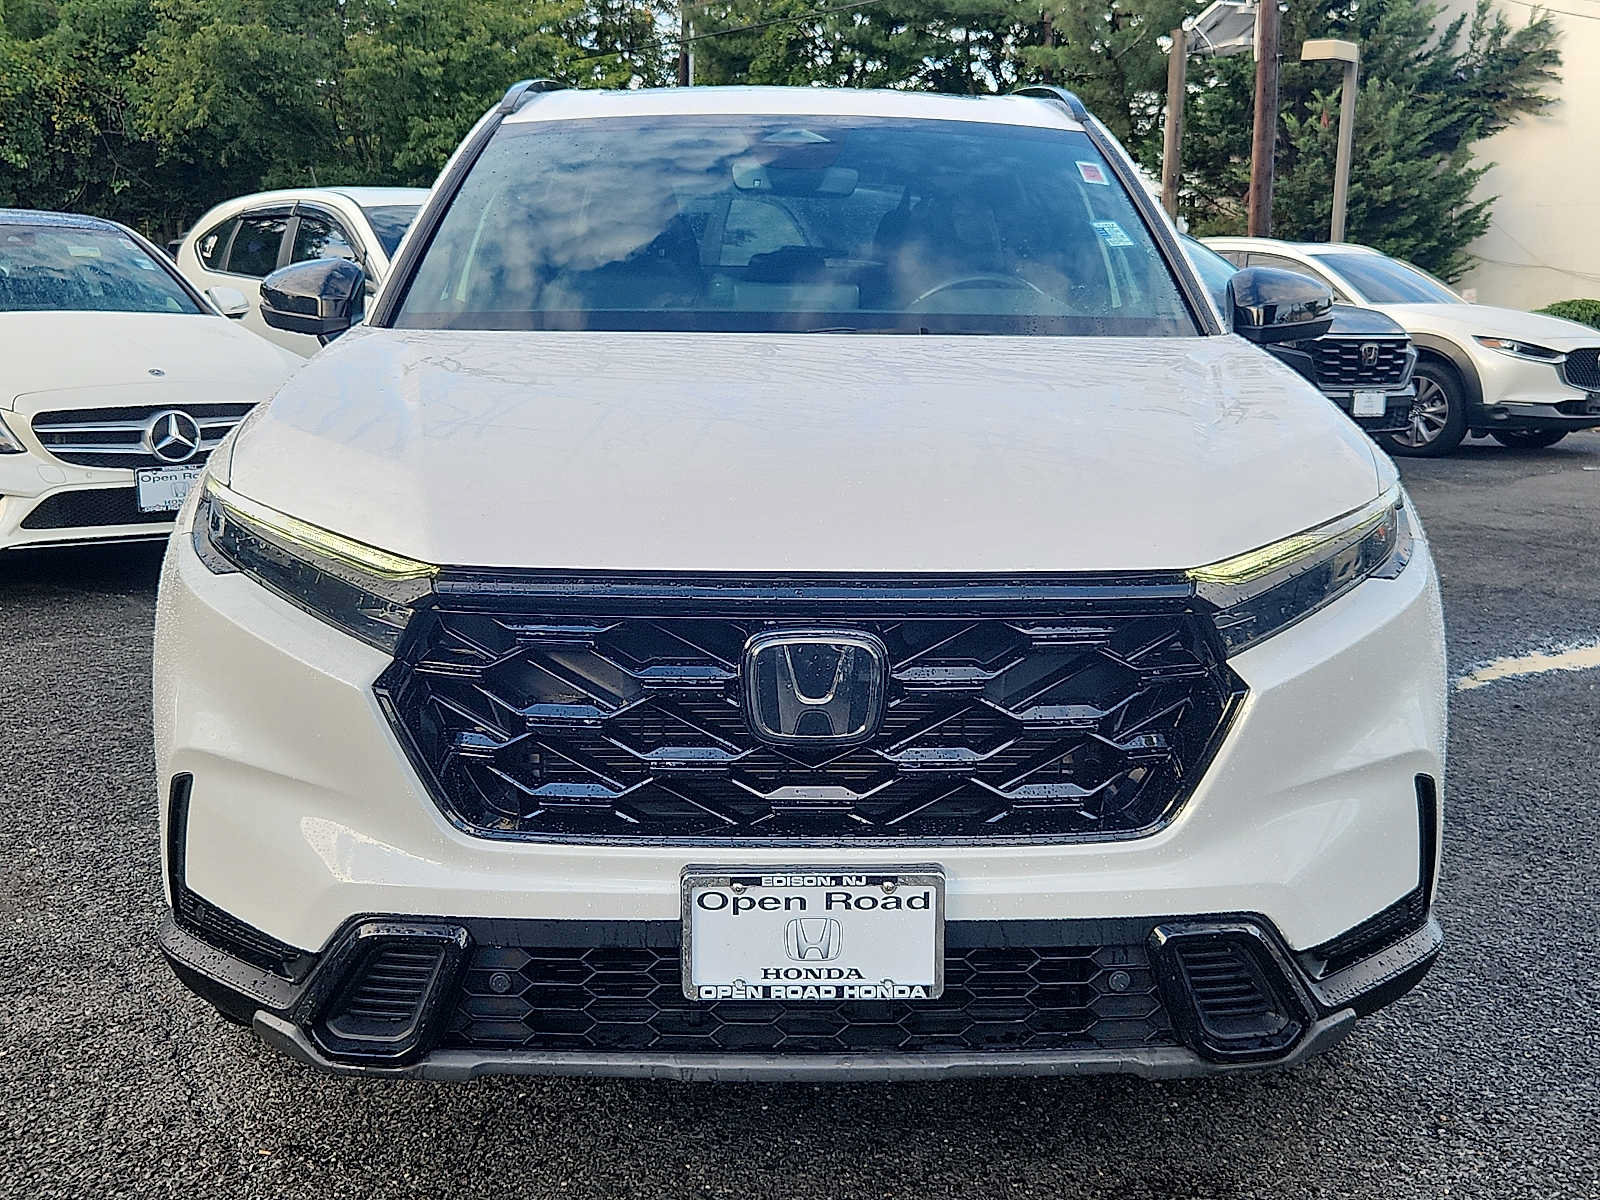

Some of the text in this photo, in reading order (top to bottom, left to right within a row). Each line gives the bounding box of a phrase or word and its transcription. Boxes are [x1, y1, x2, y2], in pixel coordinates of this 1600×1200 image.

[141, 472, 199, 483] Open Ro
[761, 876, 866, 887] EDISON, NJ
[696, 891, 930, 916] Open Road
[760, 967, 866, 980] HONDA
[700, 986, 925, 999] OPEN ROAD HONDA
